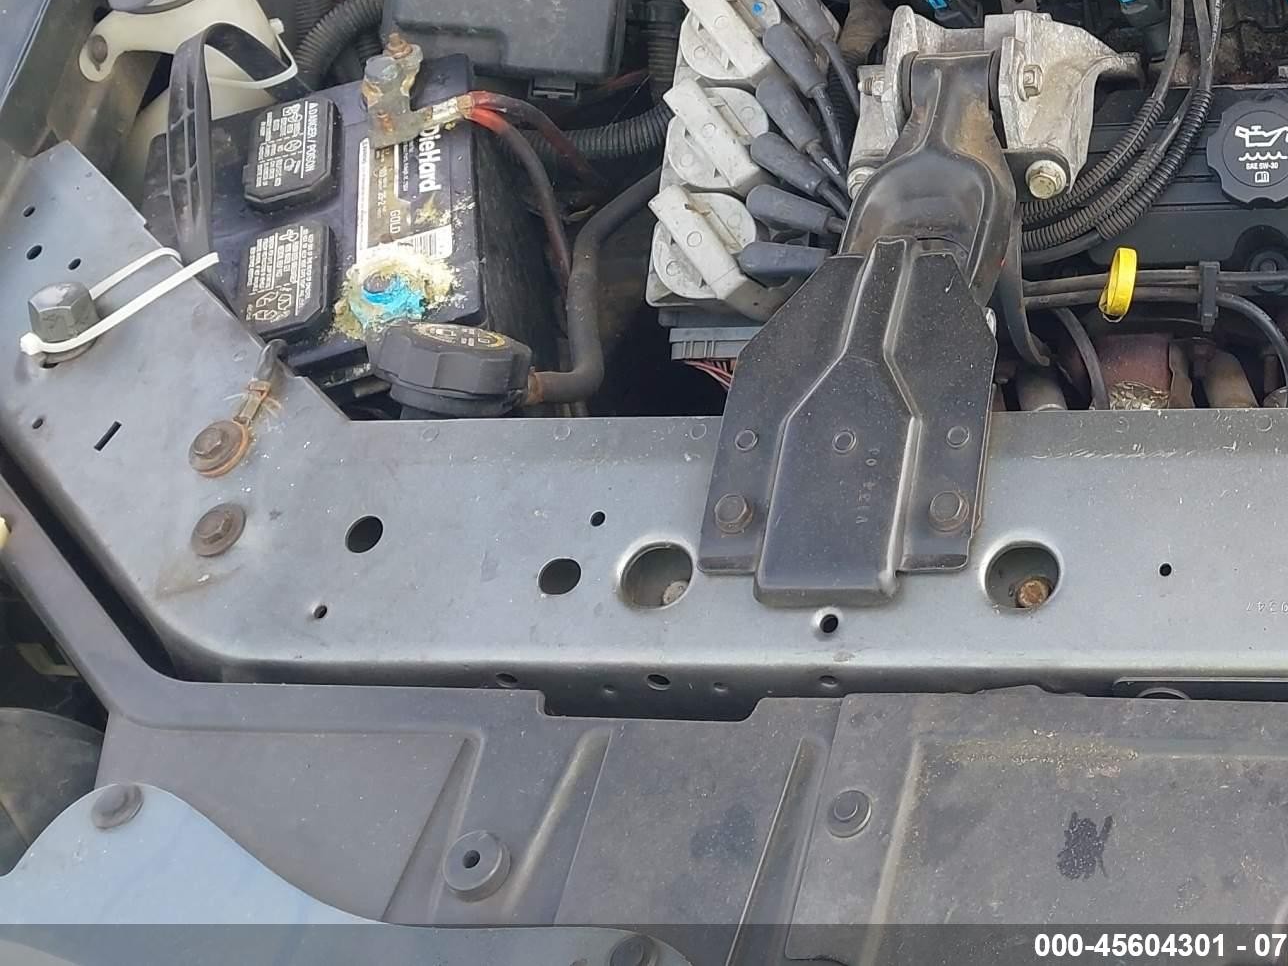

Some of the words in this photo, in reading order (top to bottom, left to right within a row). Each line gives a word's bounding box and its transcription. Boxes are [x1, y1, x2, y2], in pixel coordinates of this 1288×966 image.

[306, 107, 319, 141] DANGER
[304, 145, 318, 173] POISON
[418, 125, 442, 194] DieHard
[1245, 162, 1258, 170] SAE
[1258, 161, 1279, 170] 5W-30
[389, 209, 401, 234] GOLD
